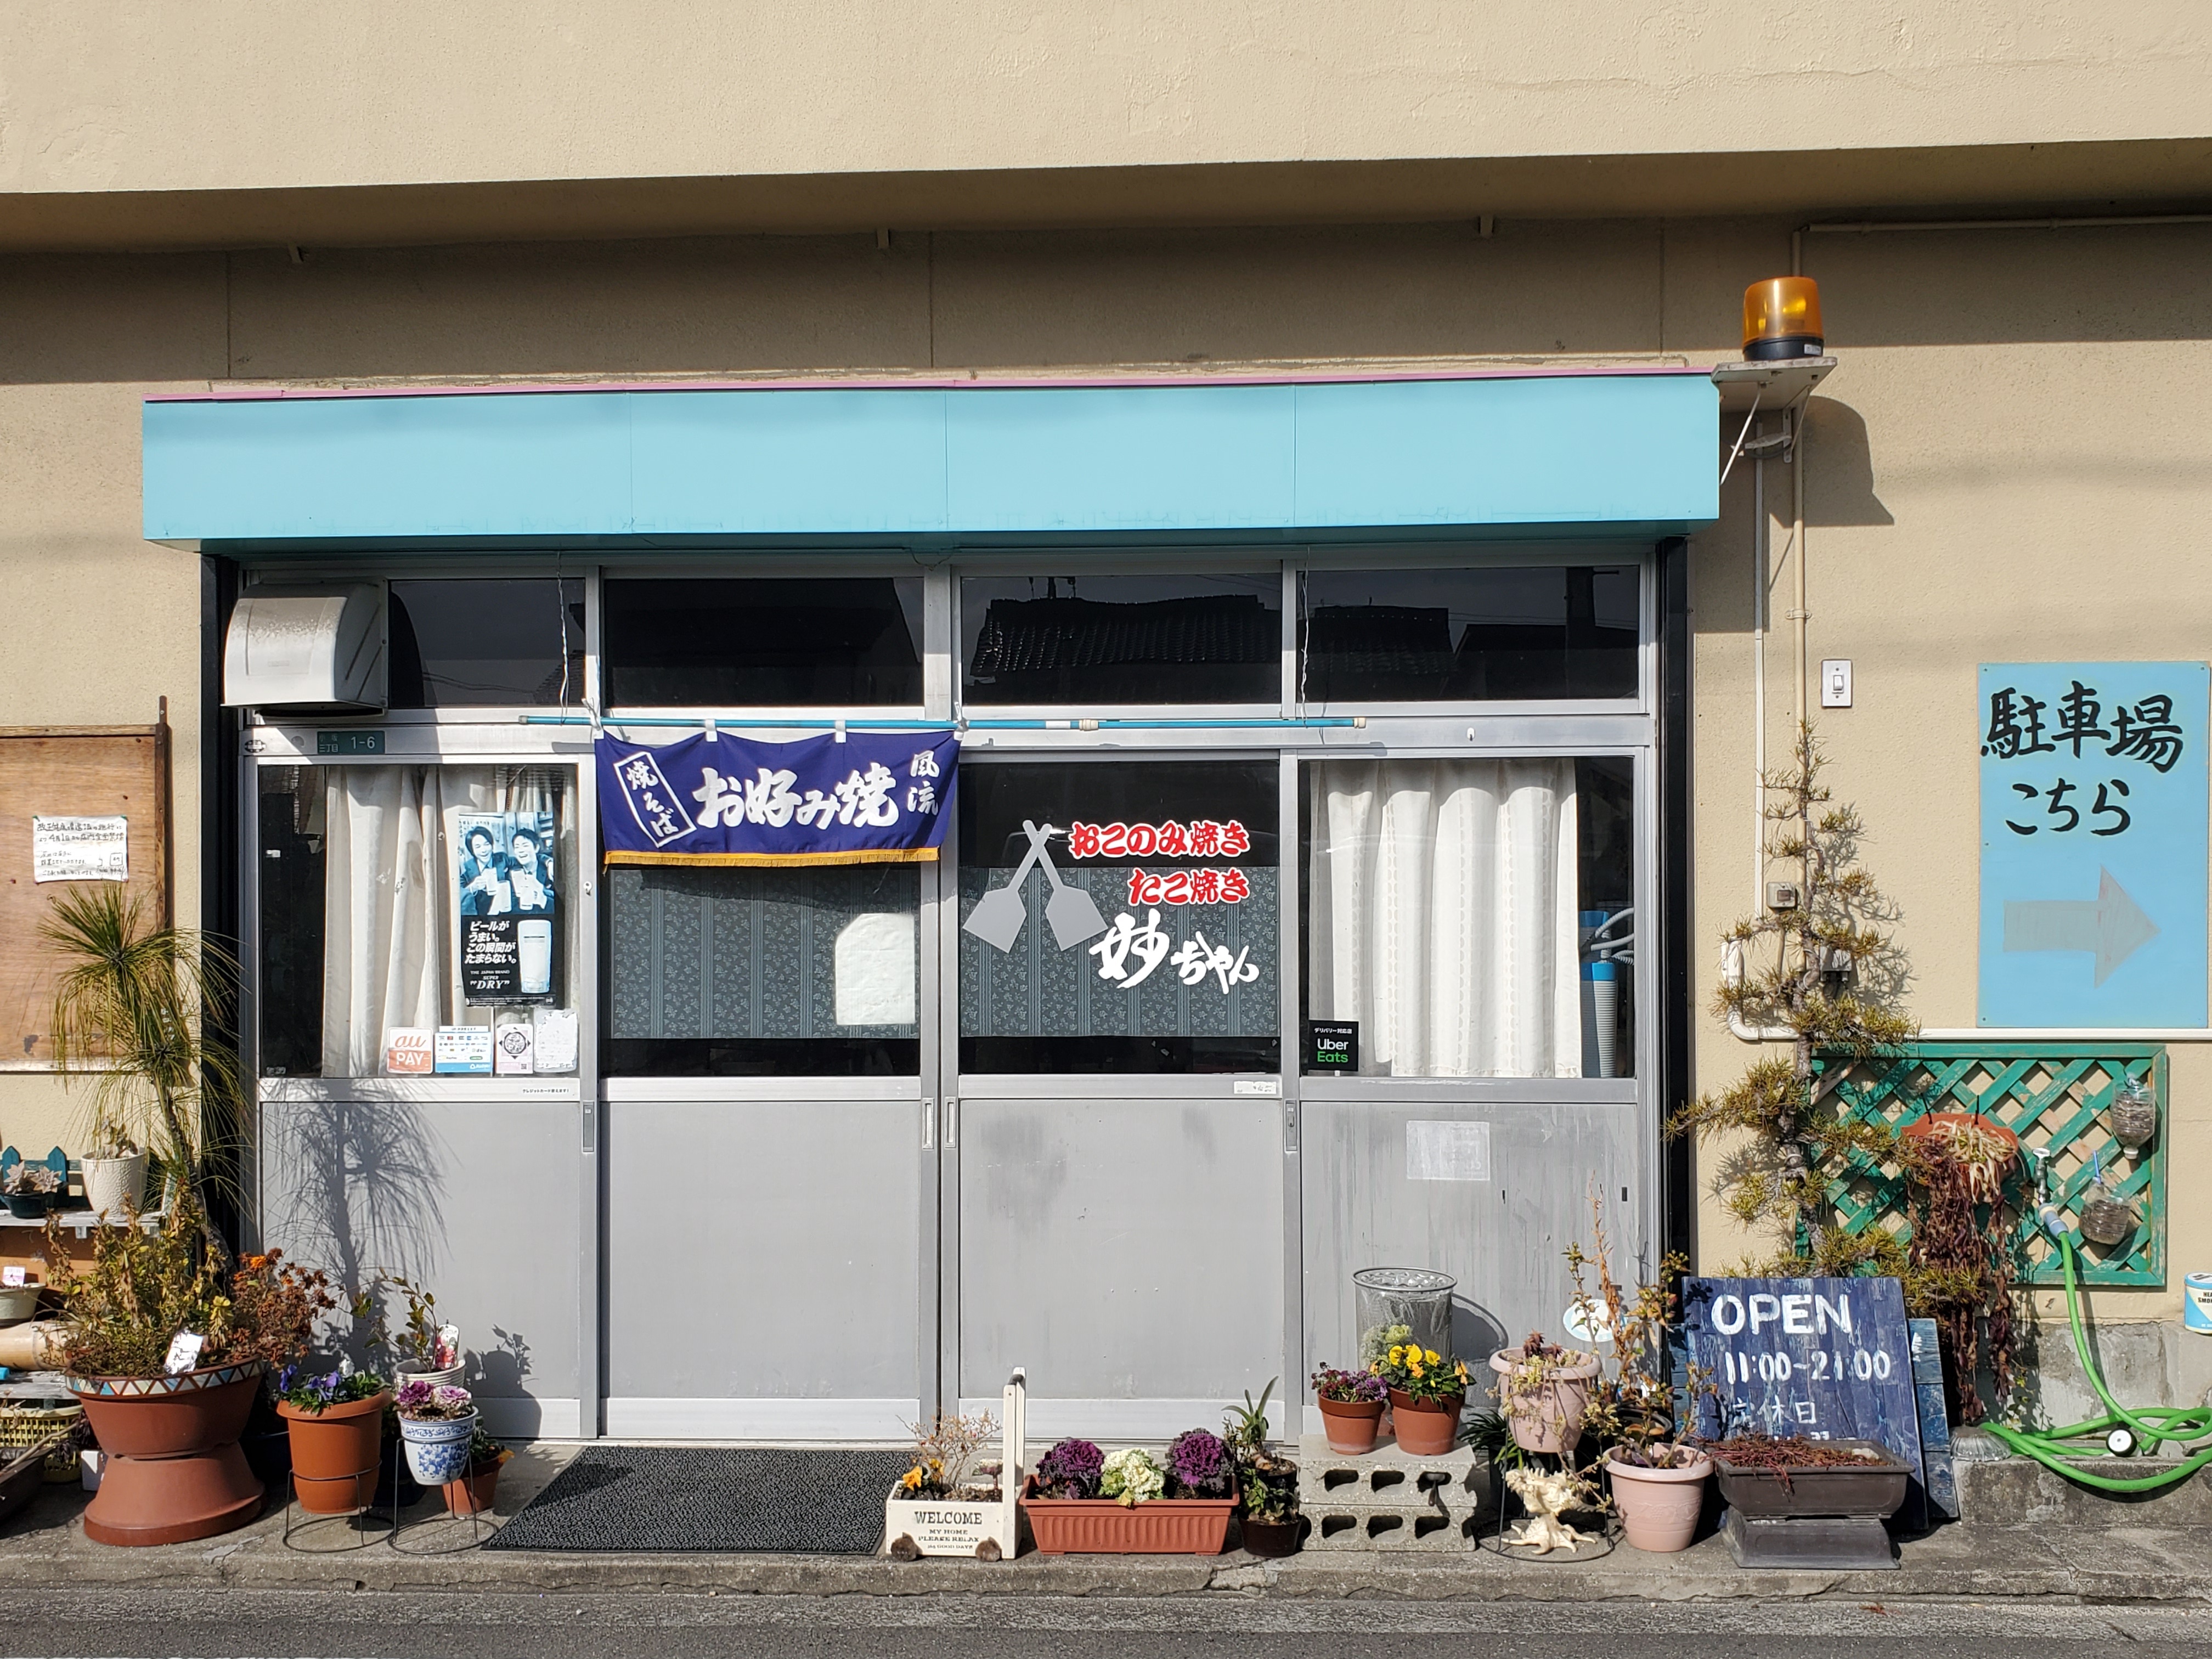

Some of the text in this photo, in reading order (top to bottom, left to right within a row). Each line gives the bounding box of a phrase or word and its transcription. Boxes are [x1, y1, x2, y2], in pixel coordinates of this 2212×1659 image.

[1980, 680, 2183, 773] 駐車場
[319, 744, 338, 752] 三丁目
[351, 736, 376, 749] 1-6
[908, 750, 940, 815] 風流
[626, 761, 679, 837] 焼そば
[692, 762, 899, 830] お好み焼
[2005, 778, 2131, 836] こちら
[1069, 820, 1250, 859] おこのみ焼き
[1128, 867, 1250, 905] たこ焼き
[470, 921, 510, 932] ビールが
[469, 932, 500, 943] うまい。
[466, 942, 517, 953] この瞬間が
[1089, 908, 1260, 995] 妙ちゃん
[465, 953, 517, 964] たまらない。
[394, 1036, 427, 1048] au
[1317, 1038, 1348, 1050] Uber
[396, 1052, 425, 1065] PAY
[1317, 1051, 1348, 1063] Eats
[1711, 1293, 1852, 1335] OPEN
[915, 1511, 982, 1525] WELCOME
